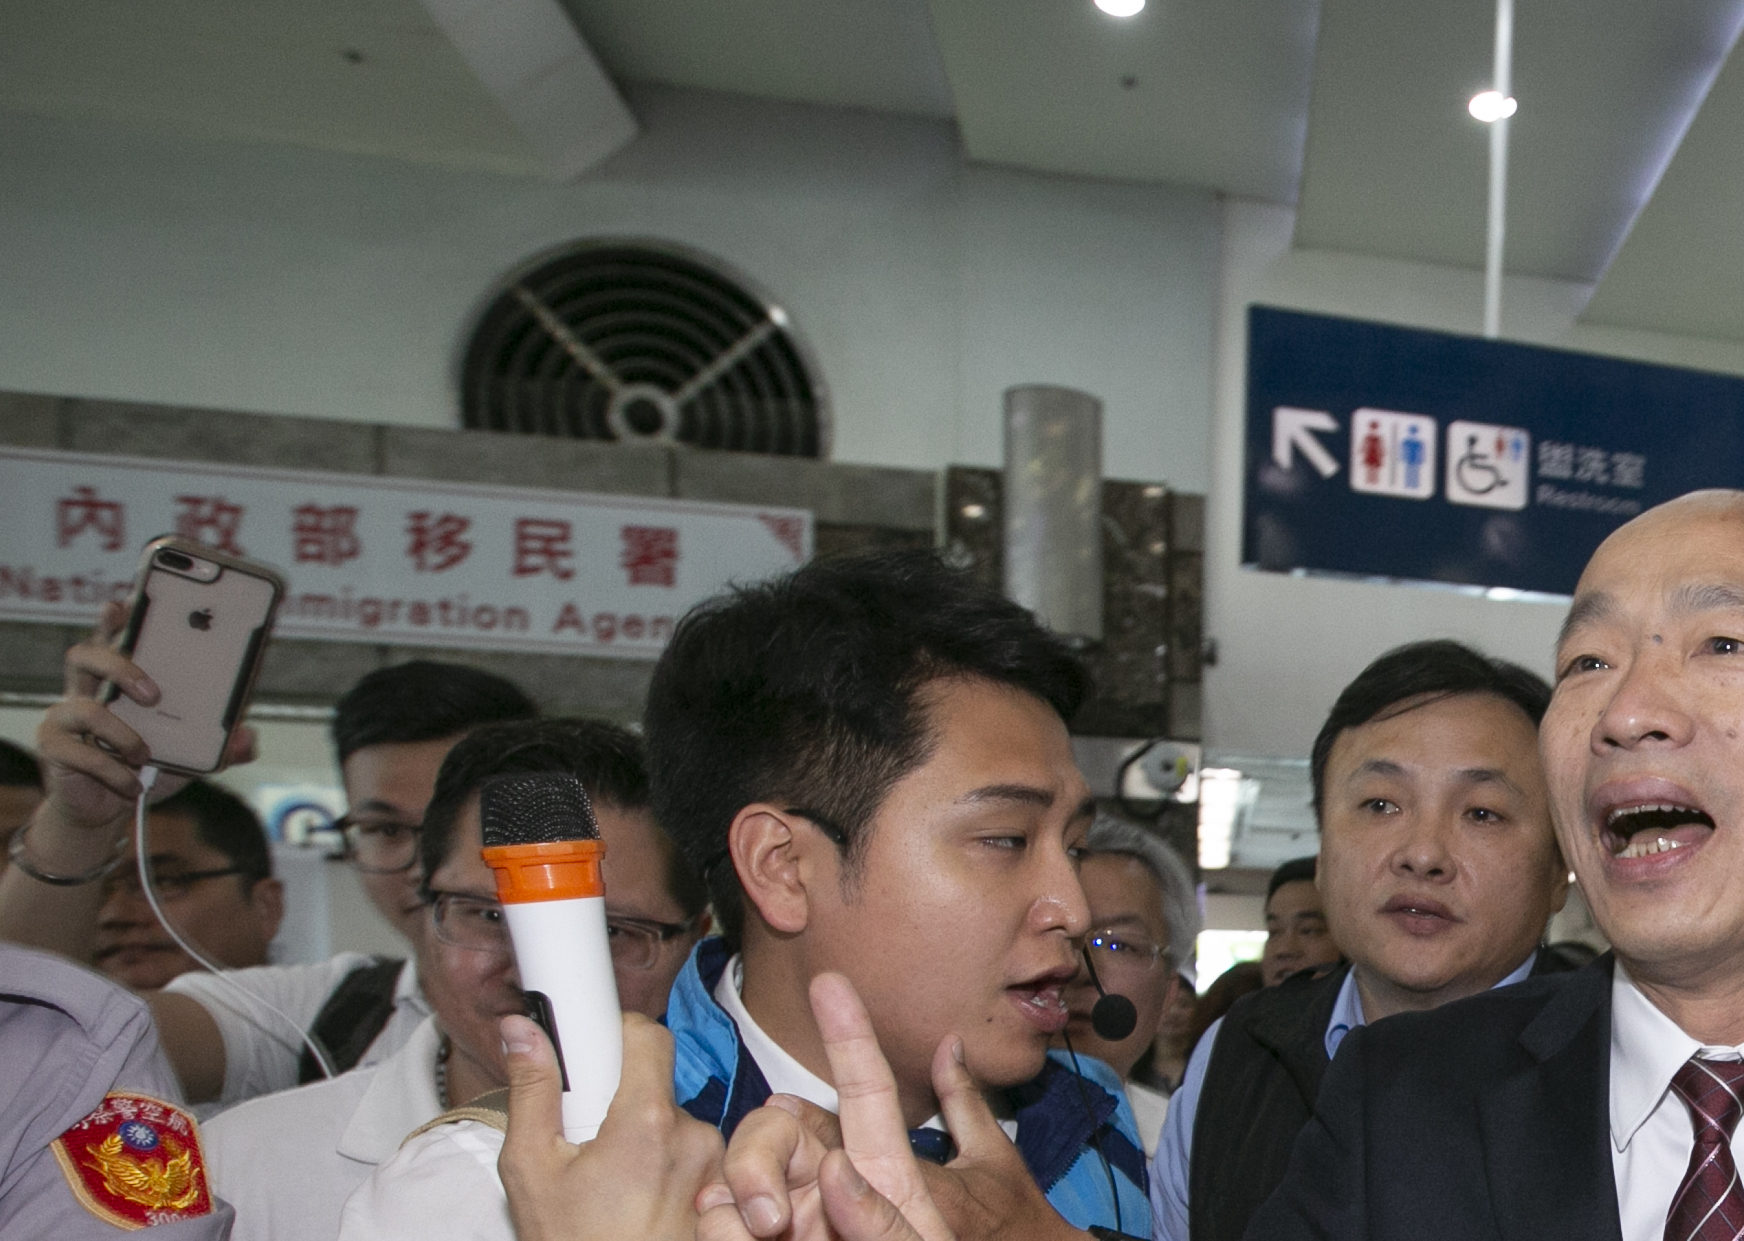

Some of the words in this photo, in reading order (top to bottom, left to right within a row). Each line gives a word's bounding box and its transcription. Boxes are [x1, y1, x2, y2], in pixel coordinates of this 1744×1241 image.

[56, 484, 681, 588] 內政部移民署
[552, 603, 675, 644] Agen
